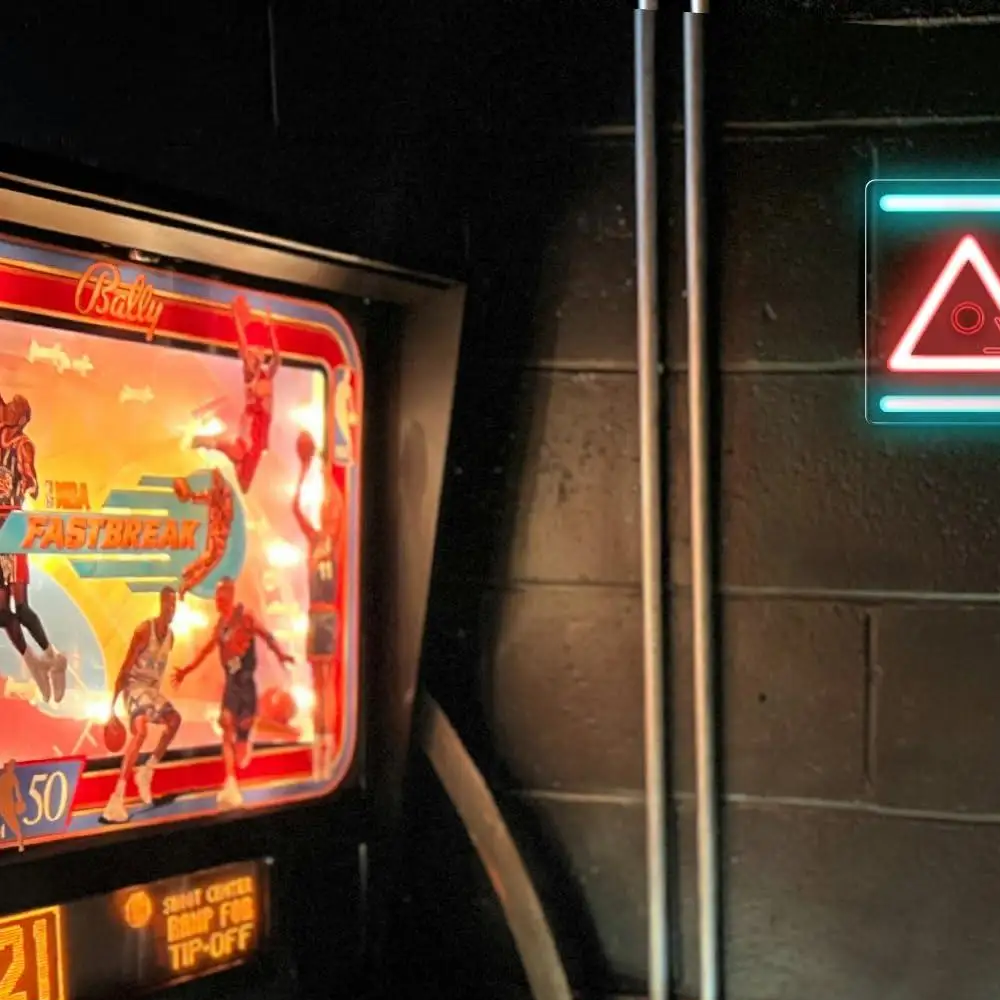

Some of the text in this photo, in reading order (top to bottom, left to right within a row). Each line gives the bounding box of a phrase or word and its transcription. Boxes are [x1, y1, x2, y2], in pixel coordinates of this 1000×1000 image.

[75, 262, 164, 341] Bally
[21, 515, 200, 550] FASTBREAK
[23, 771, 68, 826] 50
[167, 923, 255, 970] TIP-OFF
